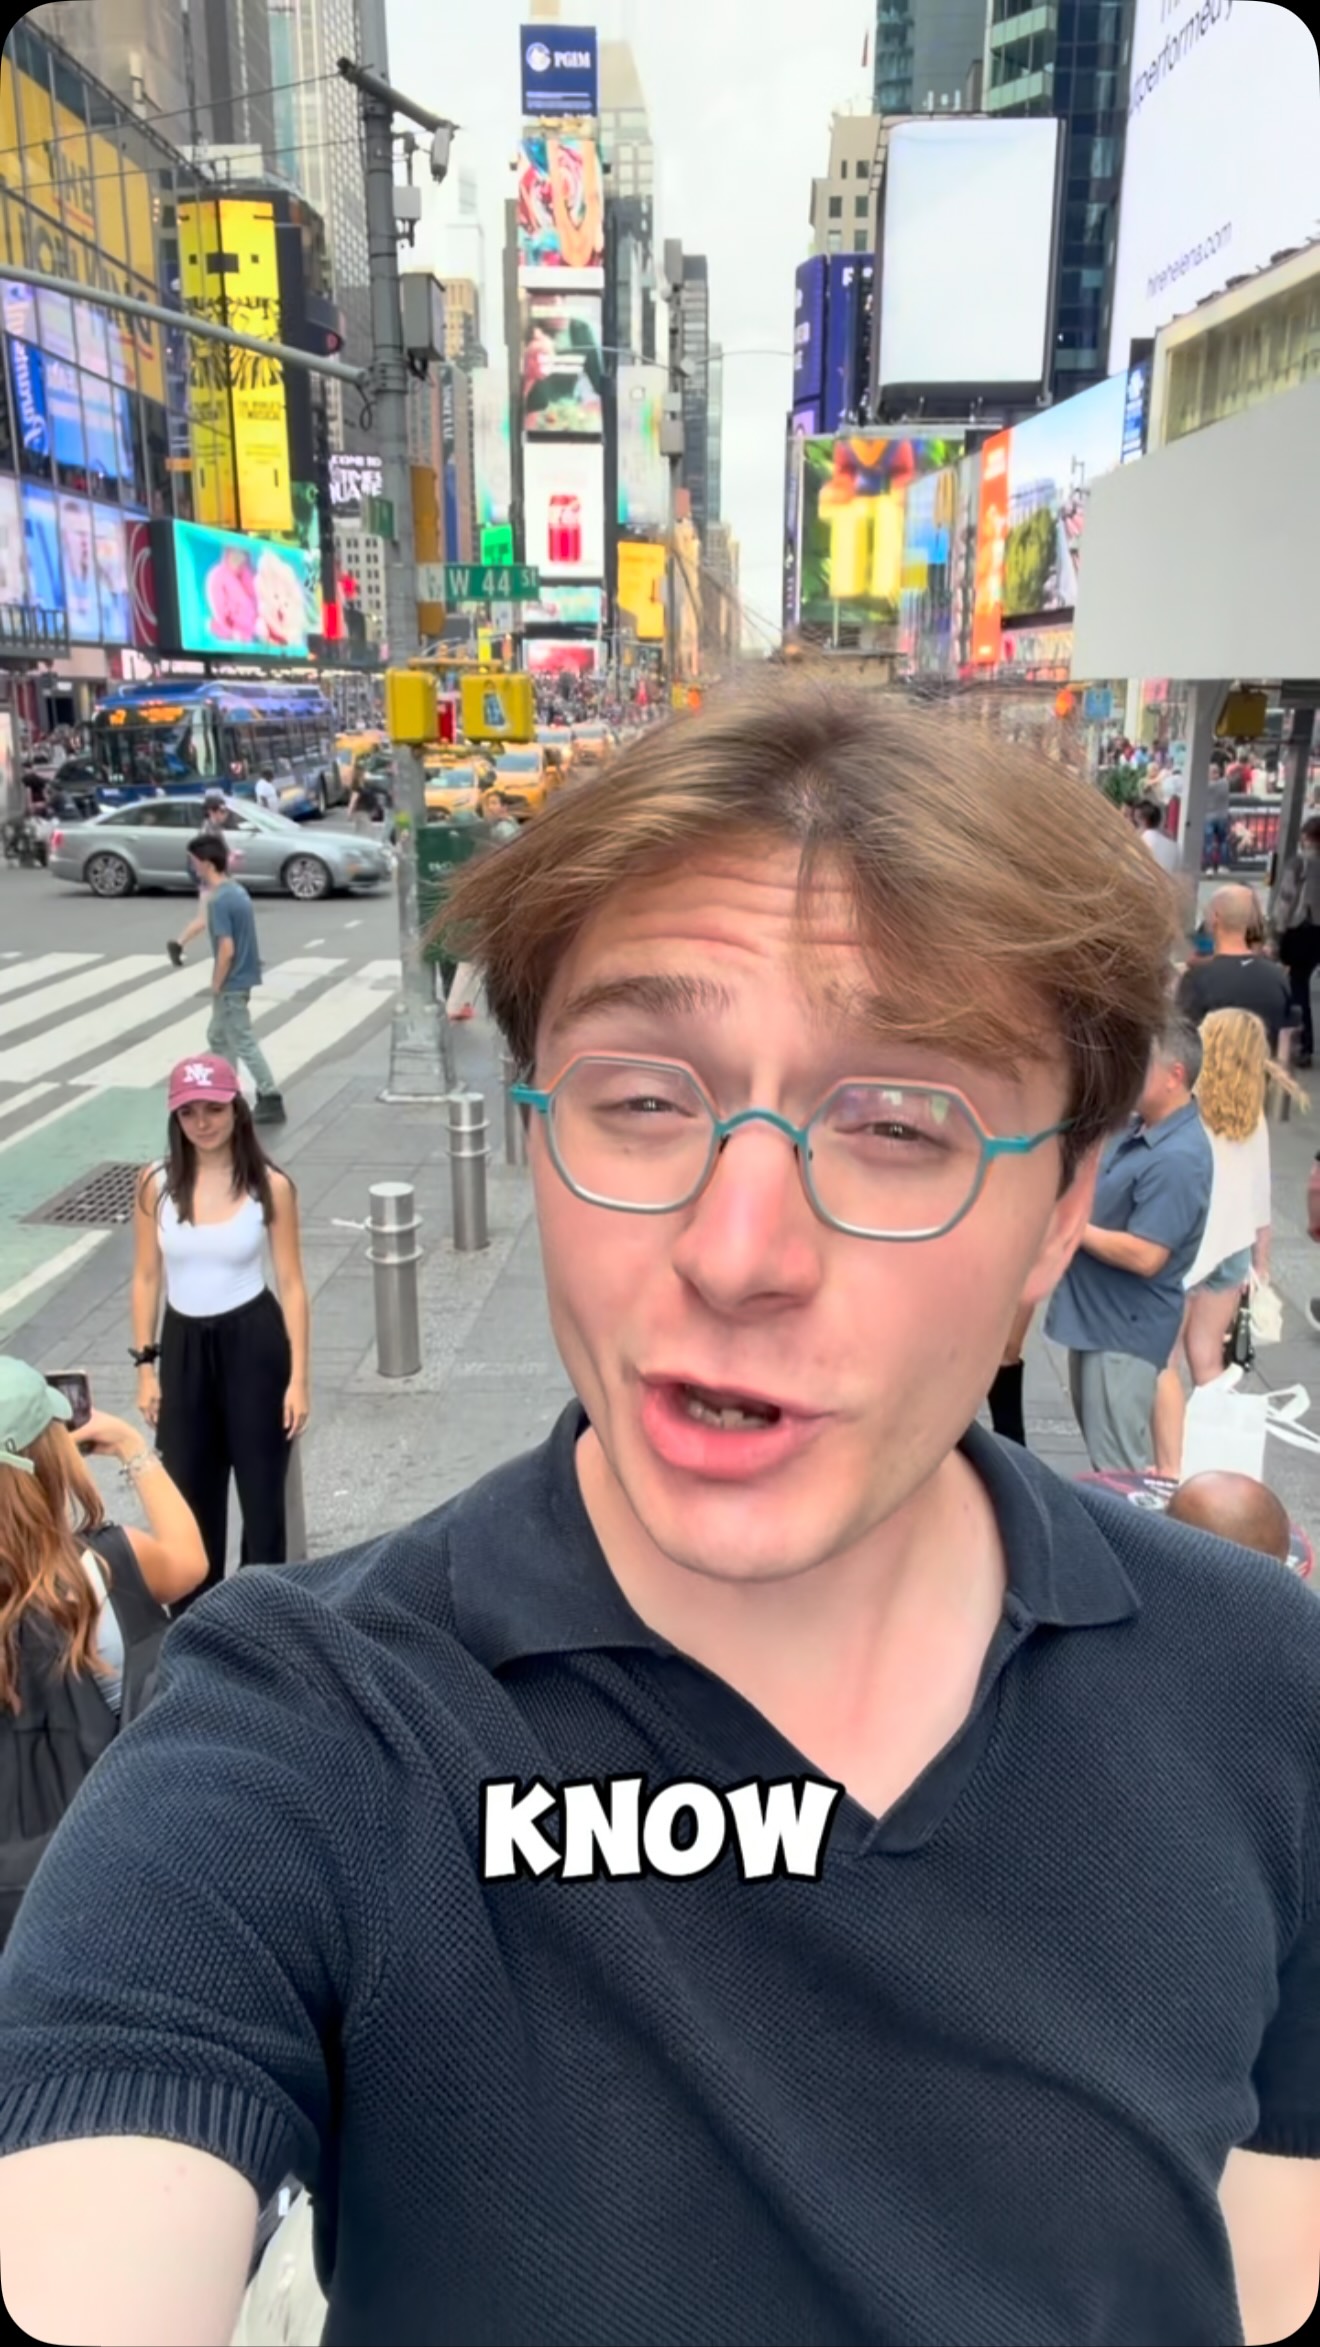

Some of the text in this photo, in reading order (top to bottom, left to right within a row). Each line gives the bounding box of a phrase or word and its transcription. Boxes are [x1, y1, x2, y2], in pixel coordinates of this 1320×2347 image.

[553, 50, 591, 69] PGIM
[448, 568, 470, 597] W
[482, 568, 512, 597] 44
[183, 1063, 215, 1087] NY
